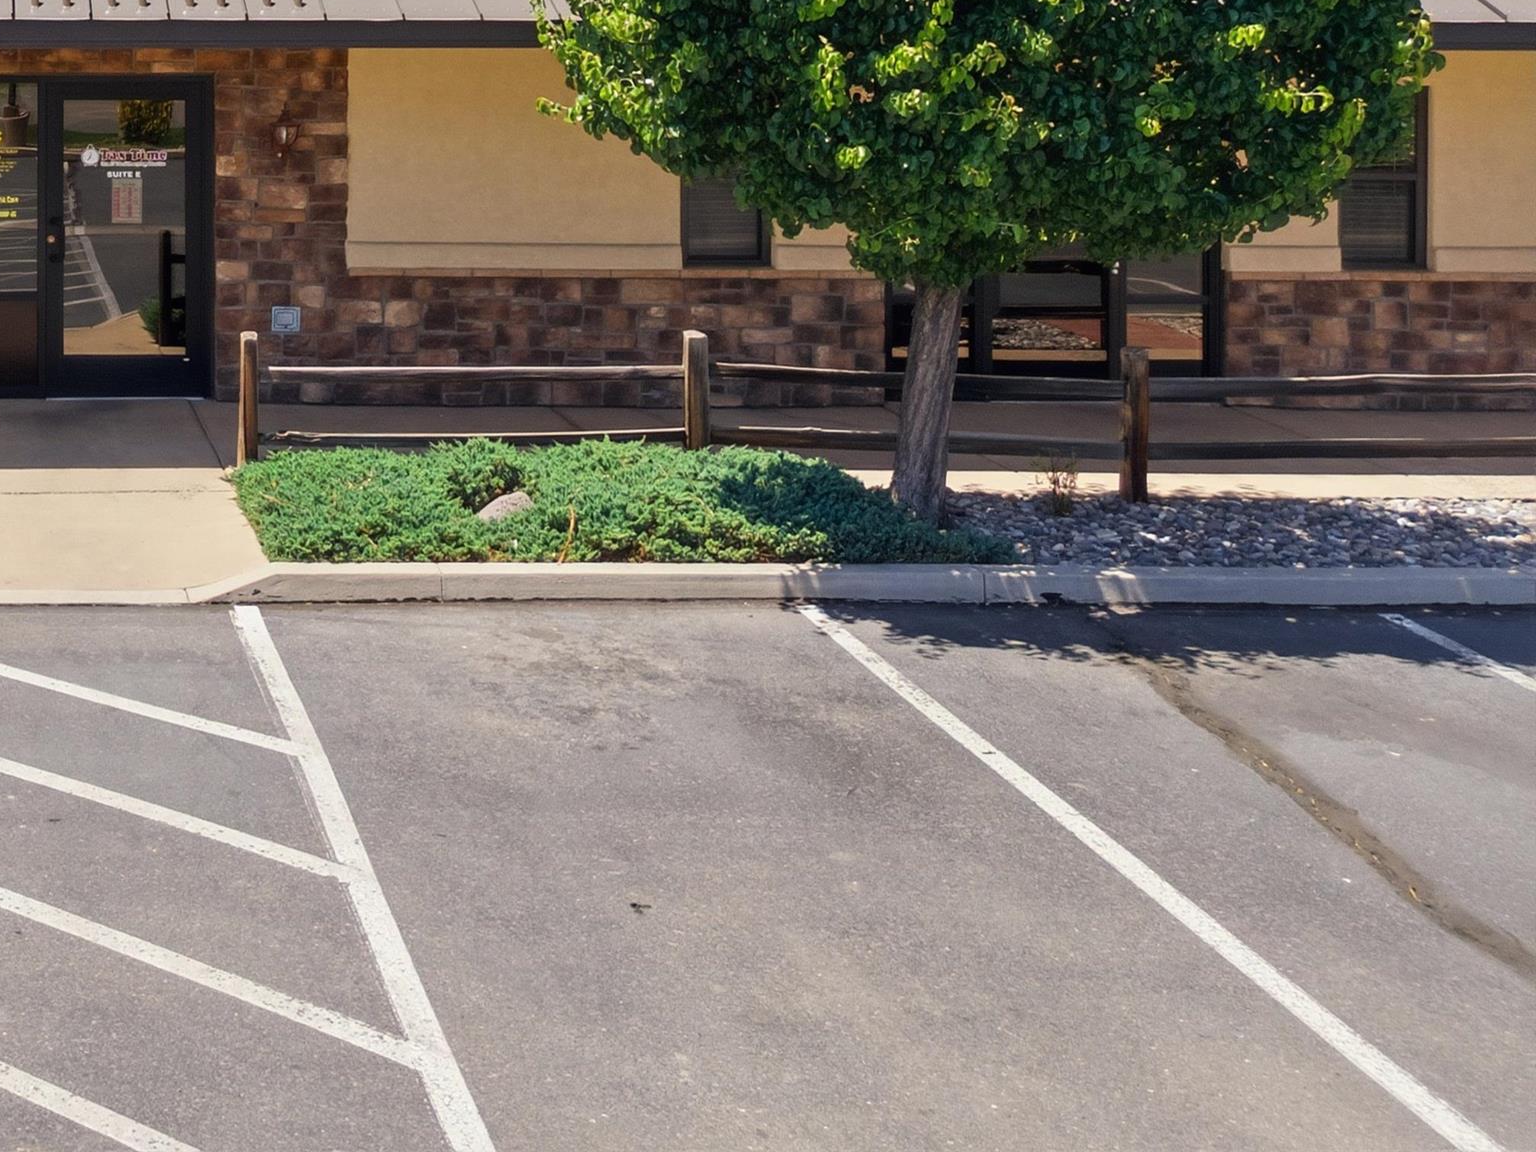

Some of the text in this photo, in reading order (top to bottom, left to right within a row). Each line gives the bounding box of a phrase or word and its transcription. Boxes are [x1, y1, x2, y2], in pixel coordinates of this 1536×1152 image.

[100, 148, 168, 161] Tax Time
[106, 171, 142, 179] SUITE E
